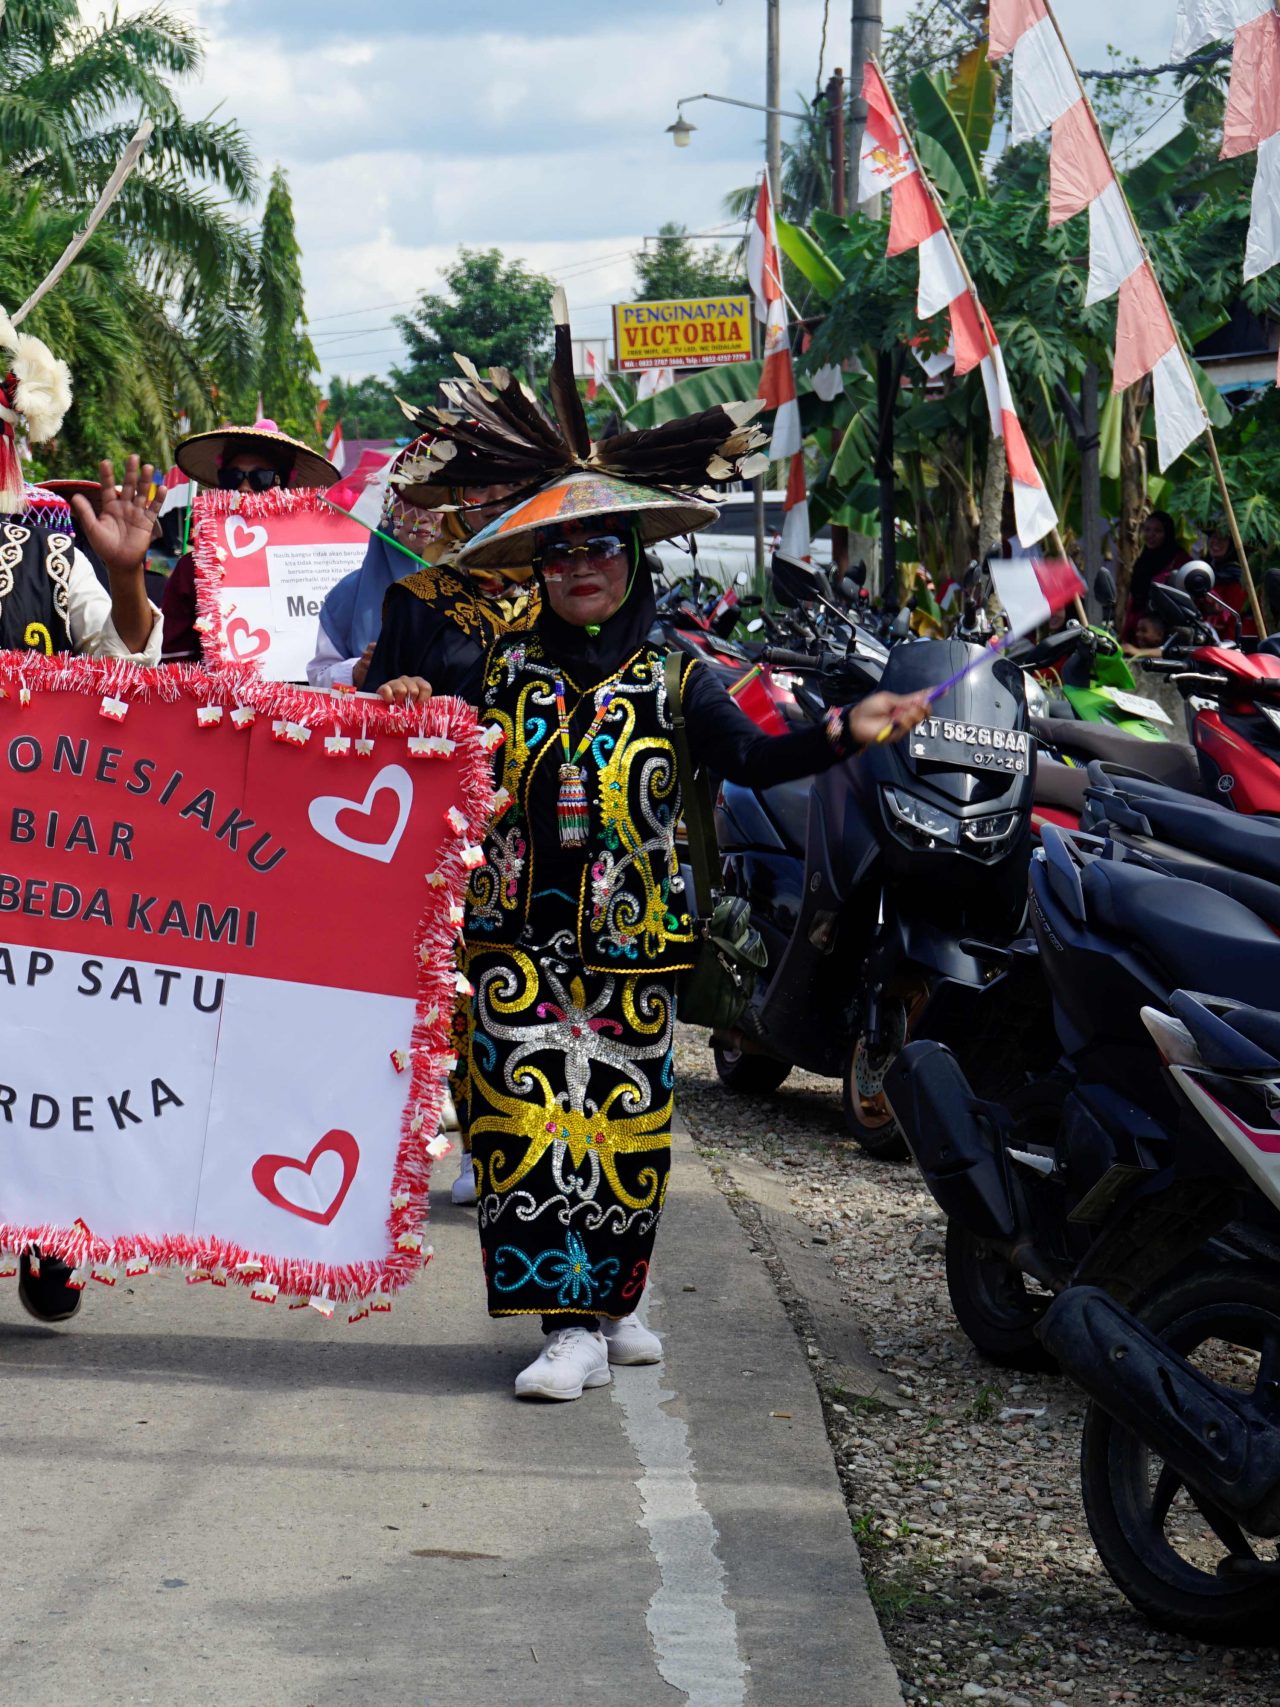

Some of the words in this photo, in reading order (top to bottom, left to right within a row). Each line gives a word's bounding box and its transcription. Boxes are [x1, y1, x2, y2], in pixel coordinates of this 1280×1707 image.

[624, 302, 743, 323] PENGINAPAN
[624, 321, 743, 347] VICTORIA
[992, 730, 1027, 753] BAA
[9, 808, 135, 861] BIAR
[126, 894, 258, 948] KAMI
[77, 960, 226, 1014] SATU
